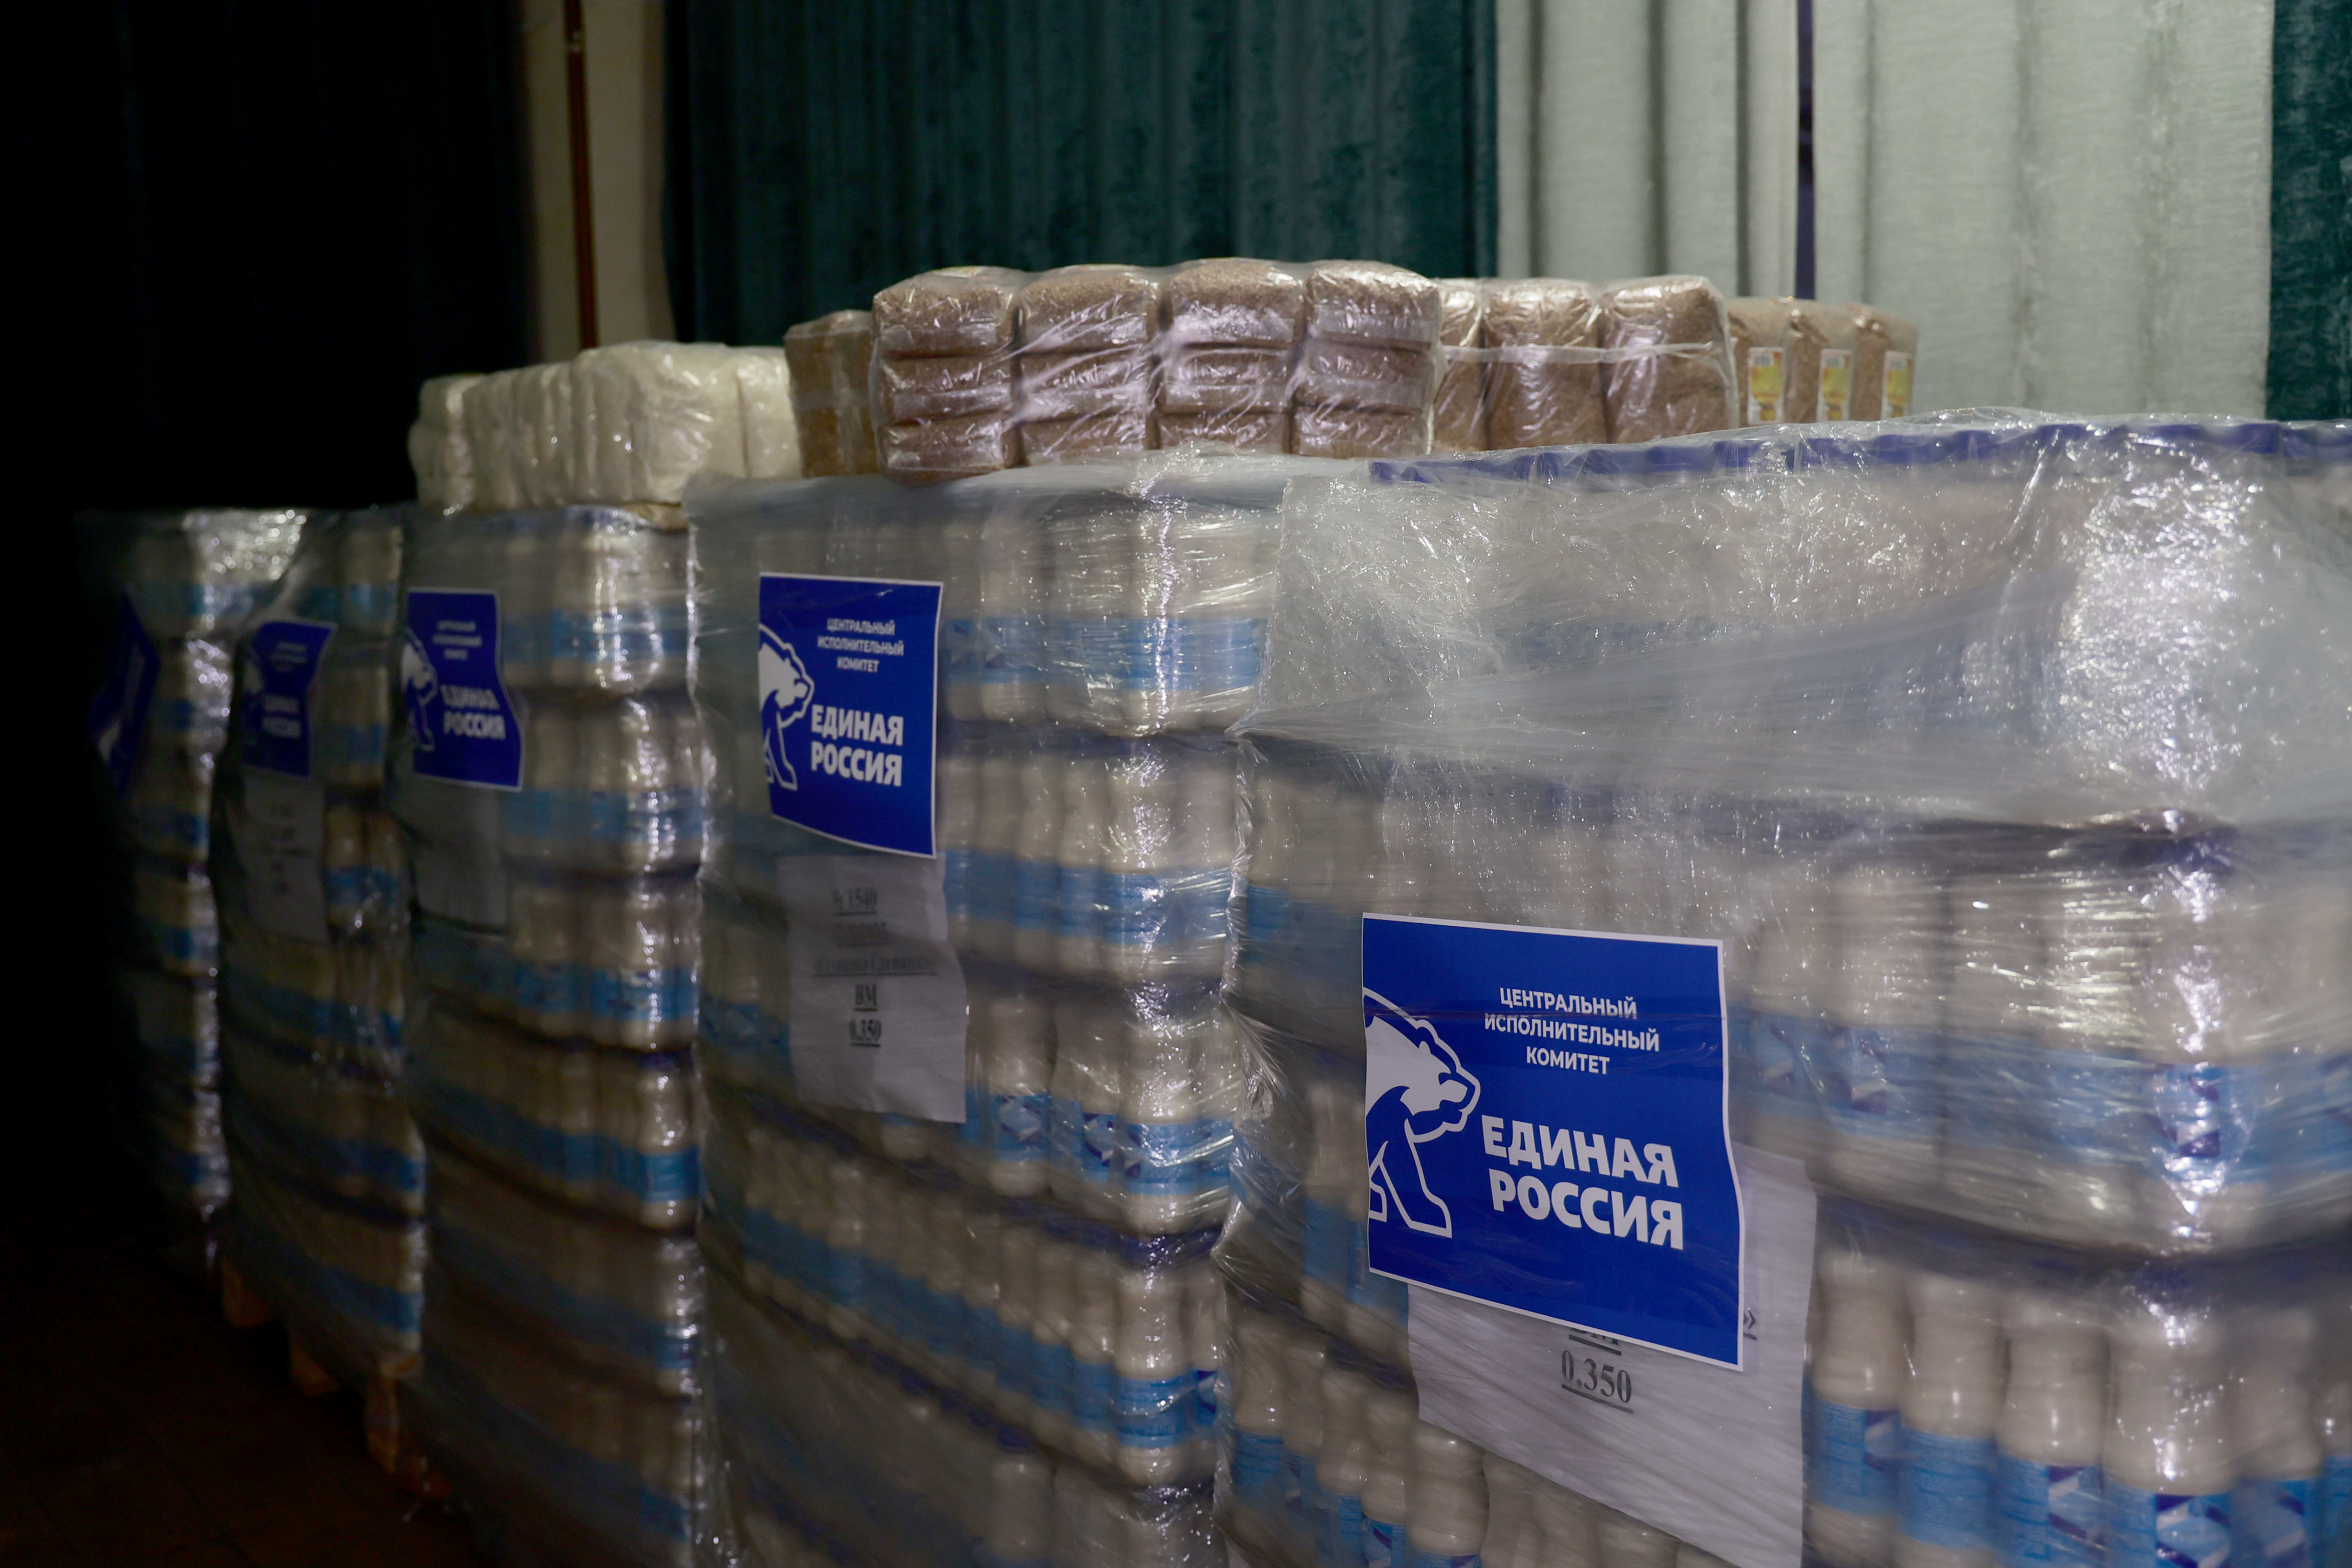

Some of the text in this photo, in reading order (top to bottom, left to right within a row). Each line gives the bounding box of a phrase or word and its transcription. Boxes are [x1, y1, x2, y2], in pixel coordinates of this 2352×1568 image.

[817, 636, 904, 656] ИСПОЛНИТЕЛЬНЫЙ
[827, 618, 895, 635] ЦЕНТРАЛЬНЫЙ
[836, 656, 880, 673] КОМИТЕТ
[810, 704, 904, 747] ЕДИНАЯ
[810, 741, 903, 787] РОССИЯ
[1499, 987, 1637, 1020] ЦЕНТРАЛЬНЫЙ
[1484, 1013, 1659, 1052] ИСПОЛНИТЕЛЬНЫЙ
[1526, 1046, 1610, 1075] КОМИТЕТ
[1481, 1114, 1679, 1188] ЕДИНАЯ
[1488, 1168, 1684, 1250] РОССИЯ
[1561, 1349, 1632, 1404] 0.350
